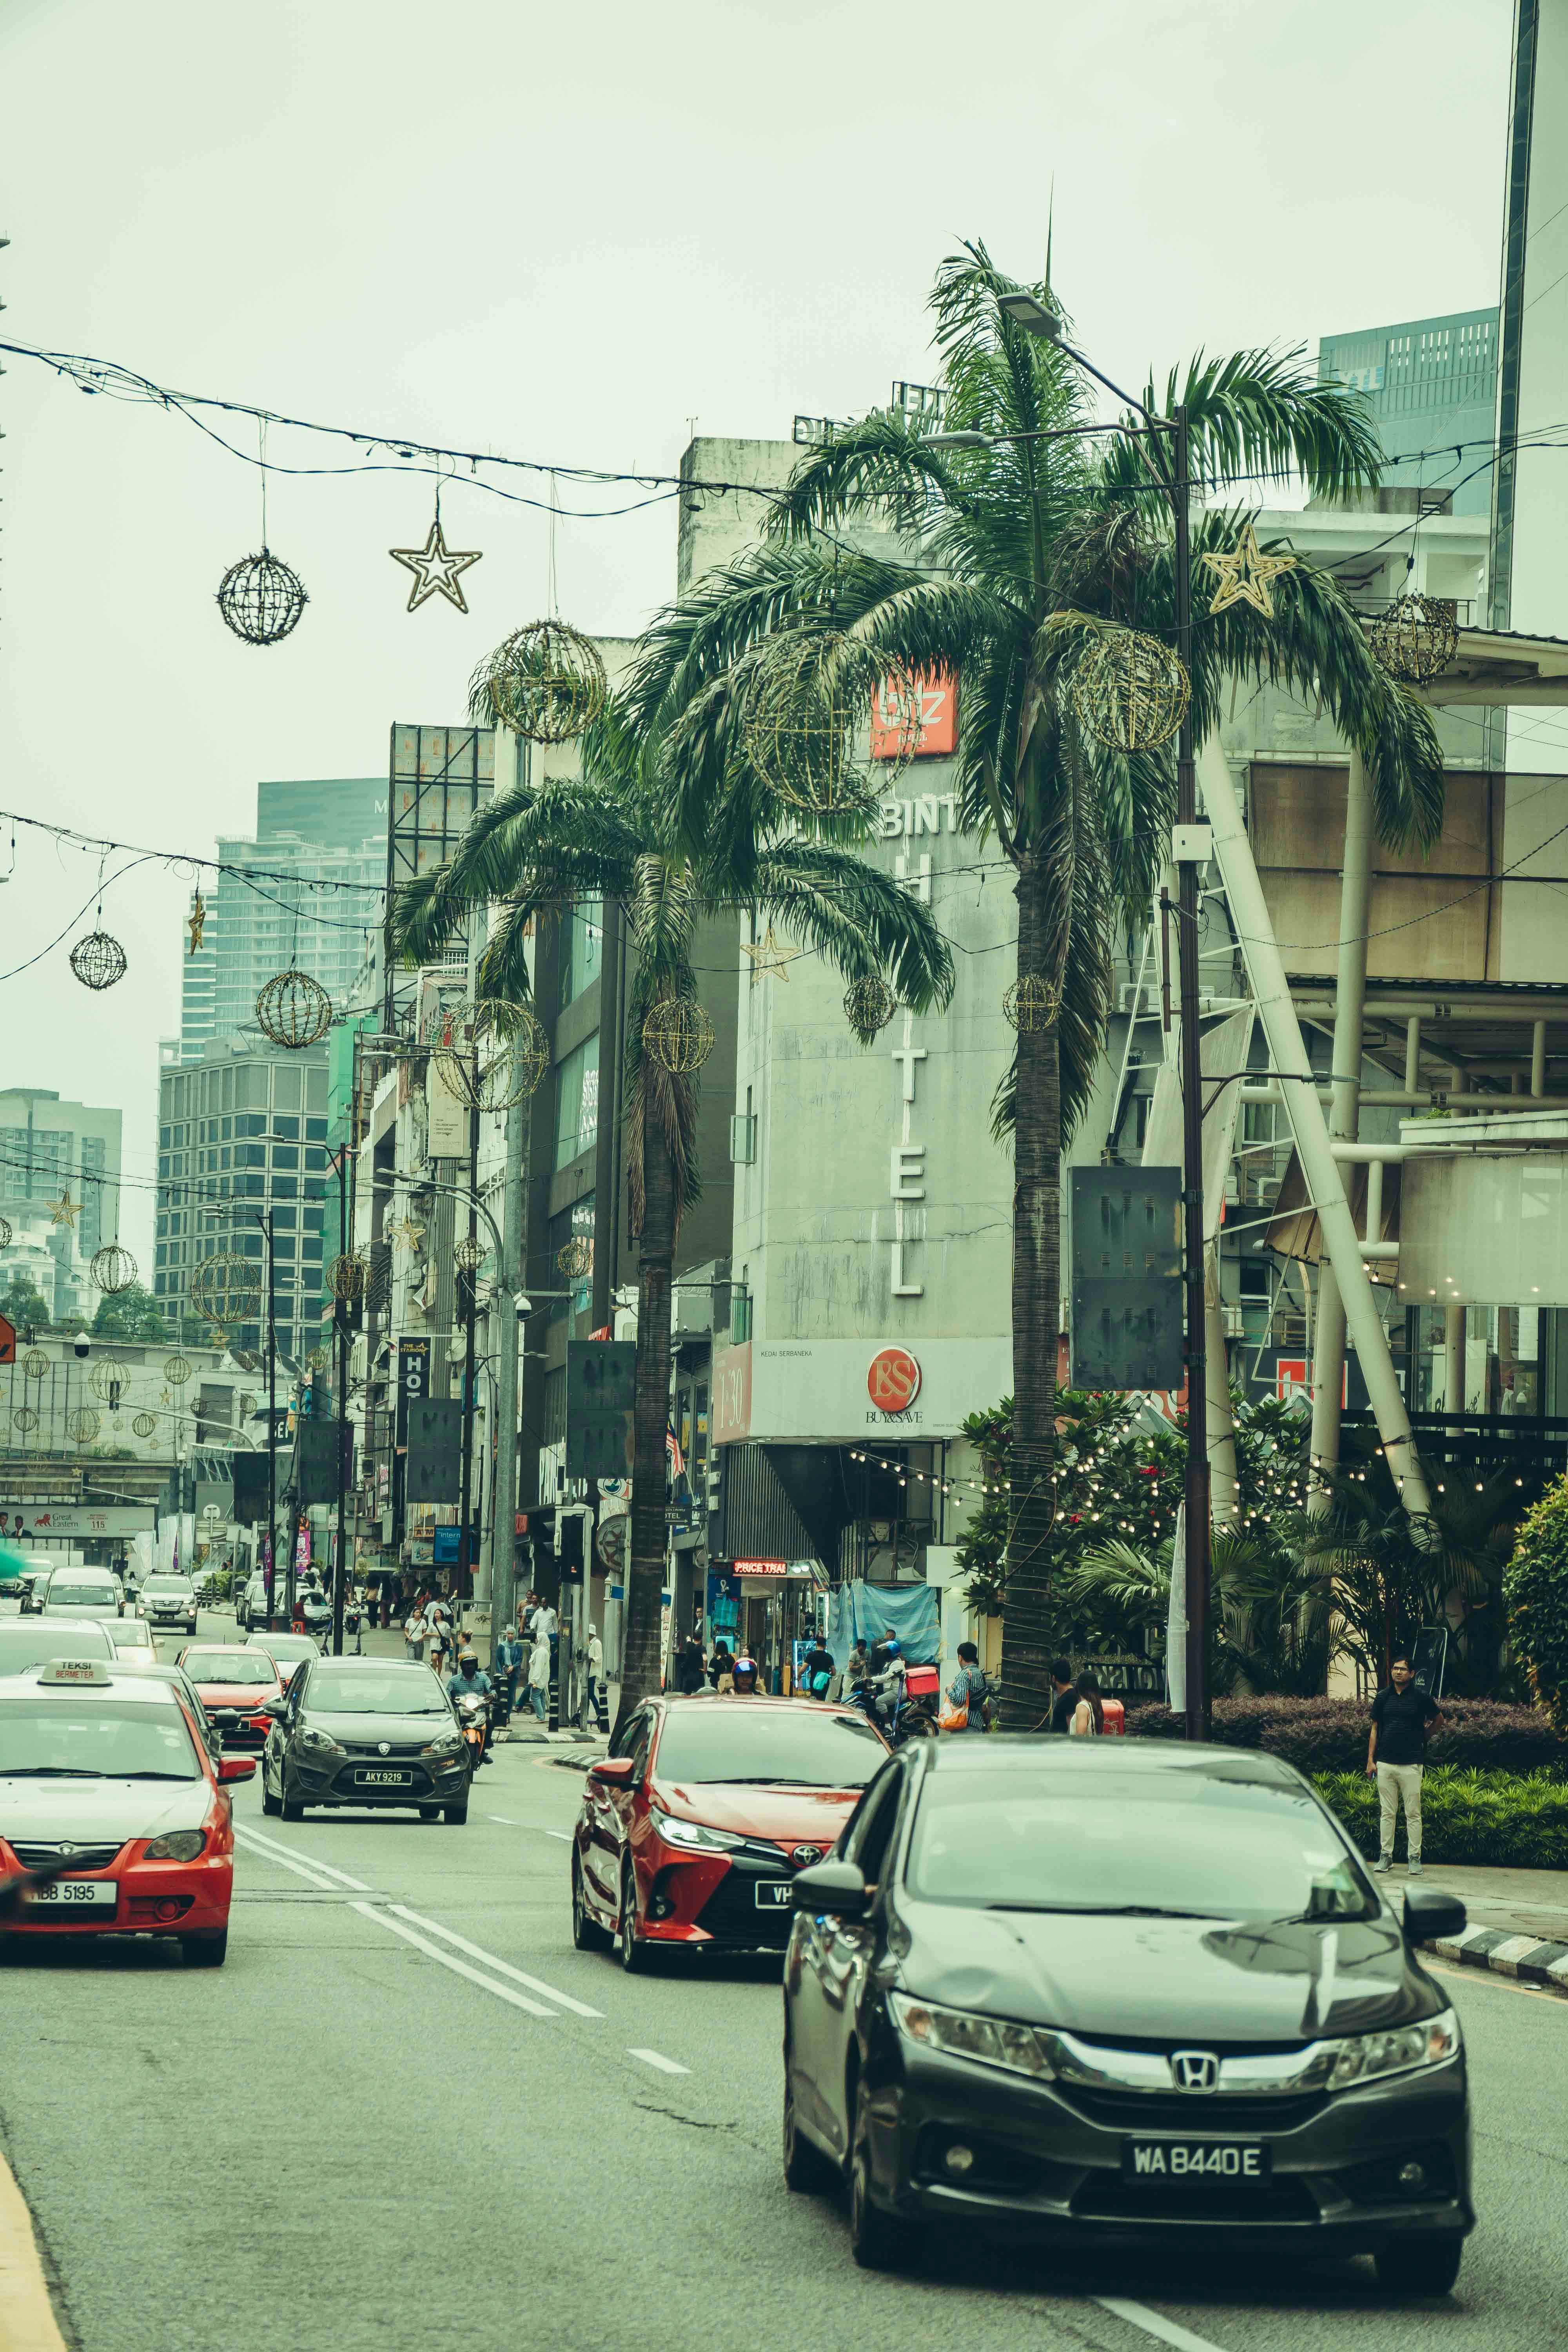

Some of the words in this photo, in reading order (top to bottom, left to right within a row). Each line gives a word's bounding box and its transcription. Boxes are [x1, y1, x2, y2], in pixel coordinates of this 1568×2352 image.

[890, 853, 933, 1296] HTEL
[866, 1411, 923, 1423] BUY&SAVE
[62, 1662, 91, 1670] TEKSI
[56, 1670, 93, 1679] BERMETER
[365, 1772, 381, 1782] AKY
[382, 1773, 402, 1782] 9219
[63, 1885, 95, 1900] 5195
